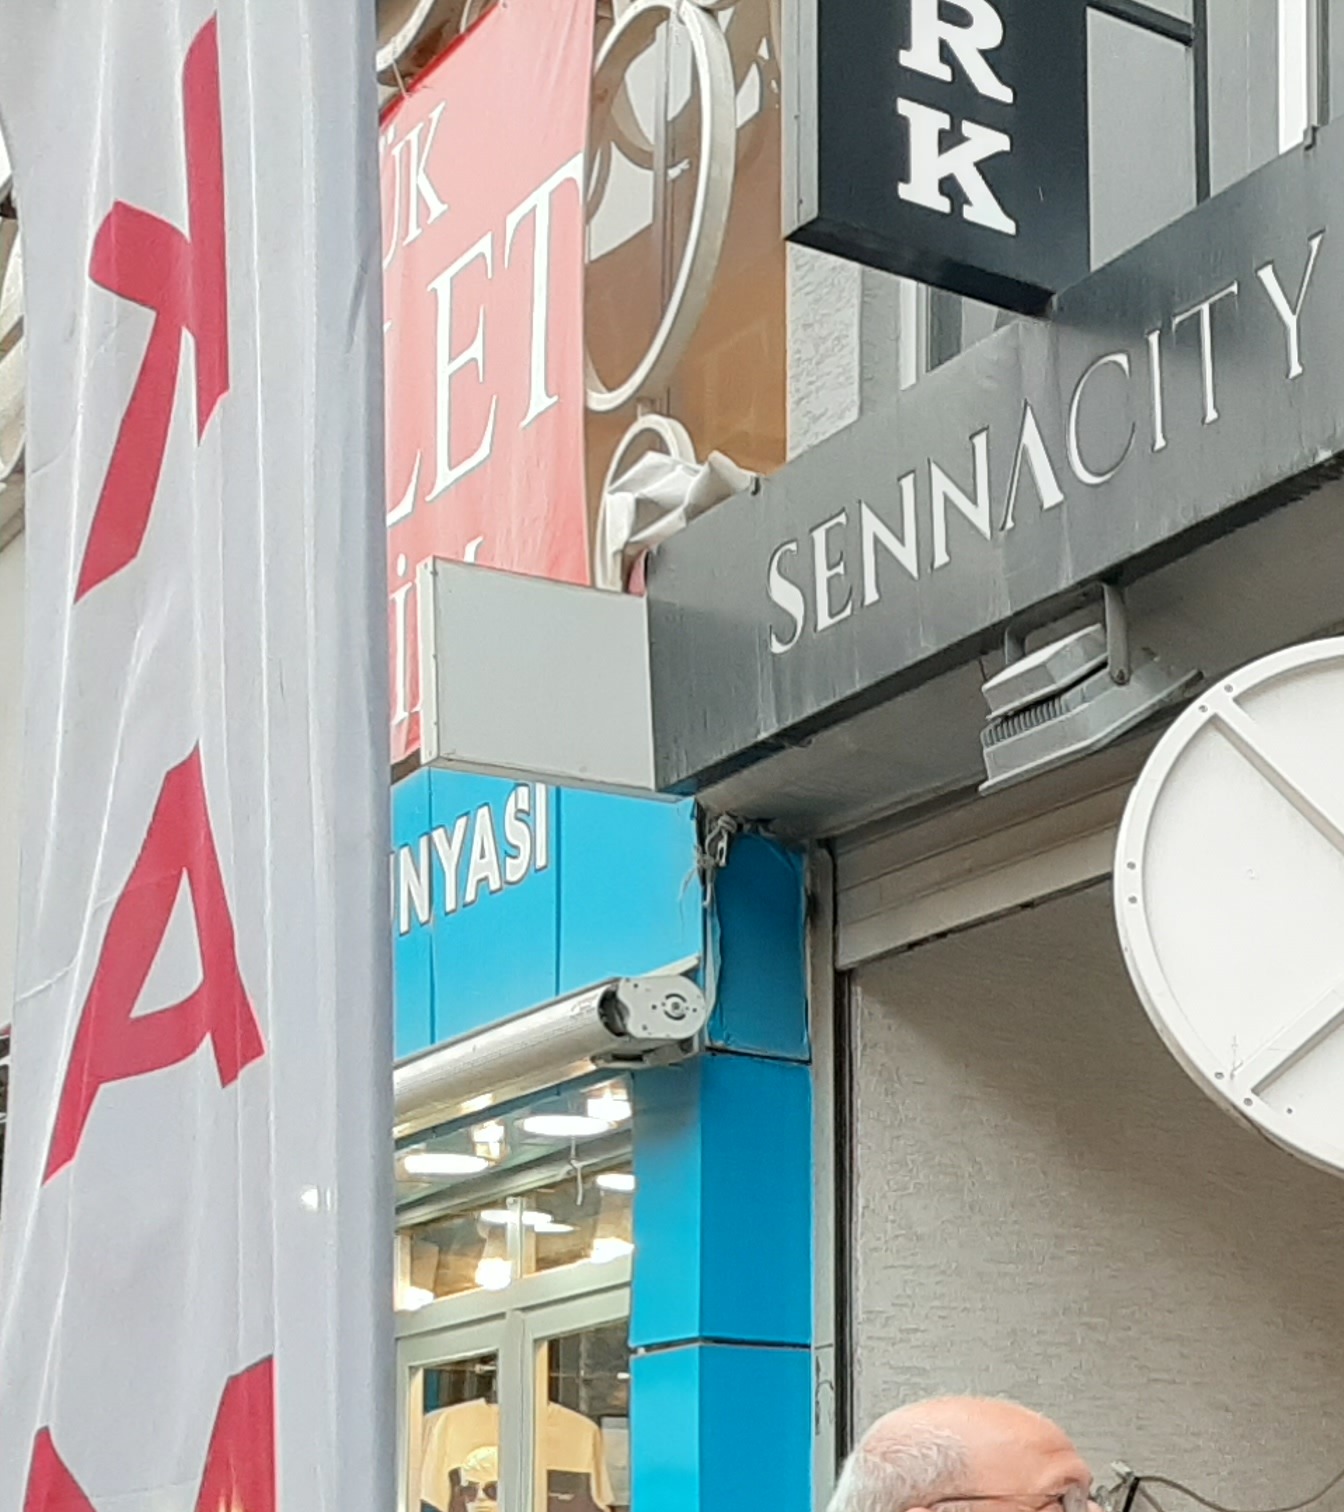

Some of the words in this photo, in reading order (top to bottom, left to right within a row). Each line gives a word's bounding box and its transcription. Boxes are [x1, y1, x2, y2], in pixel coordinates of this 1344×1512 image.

[386, 150, 583, 528] ET
[766, 229, 1326, 656] SENNACITY
[390, 783, 549, 936] NYASI
